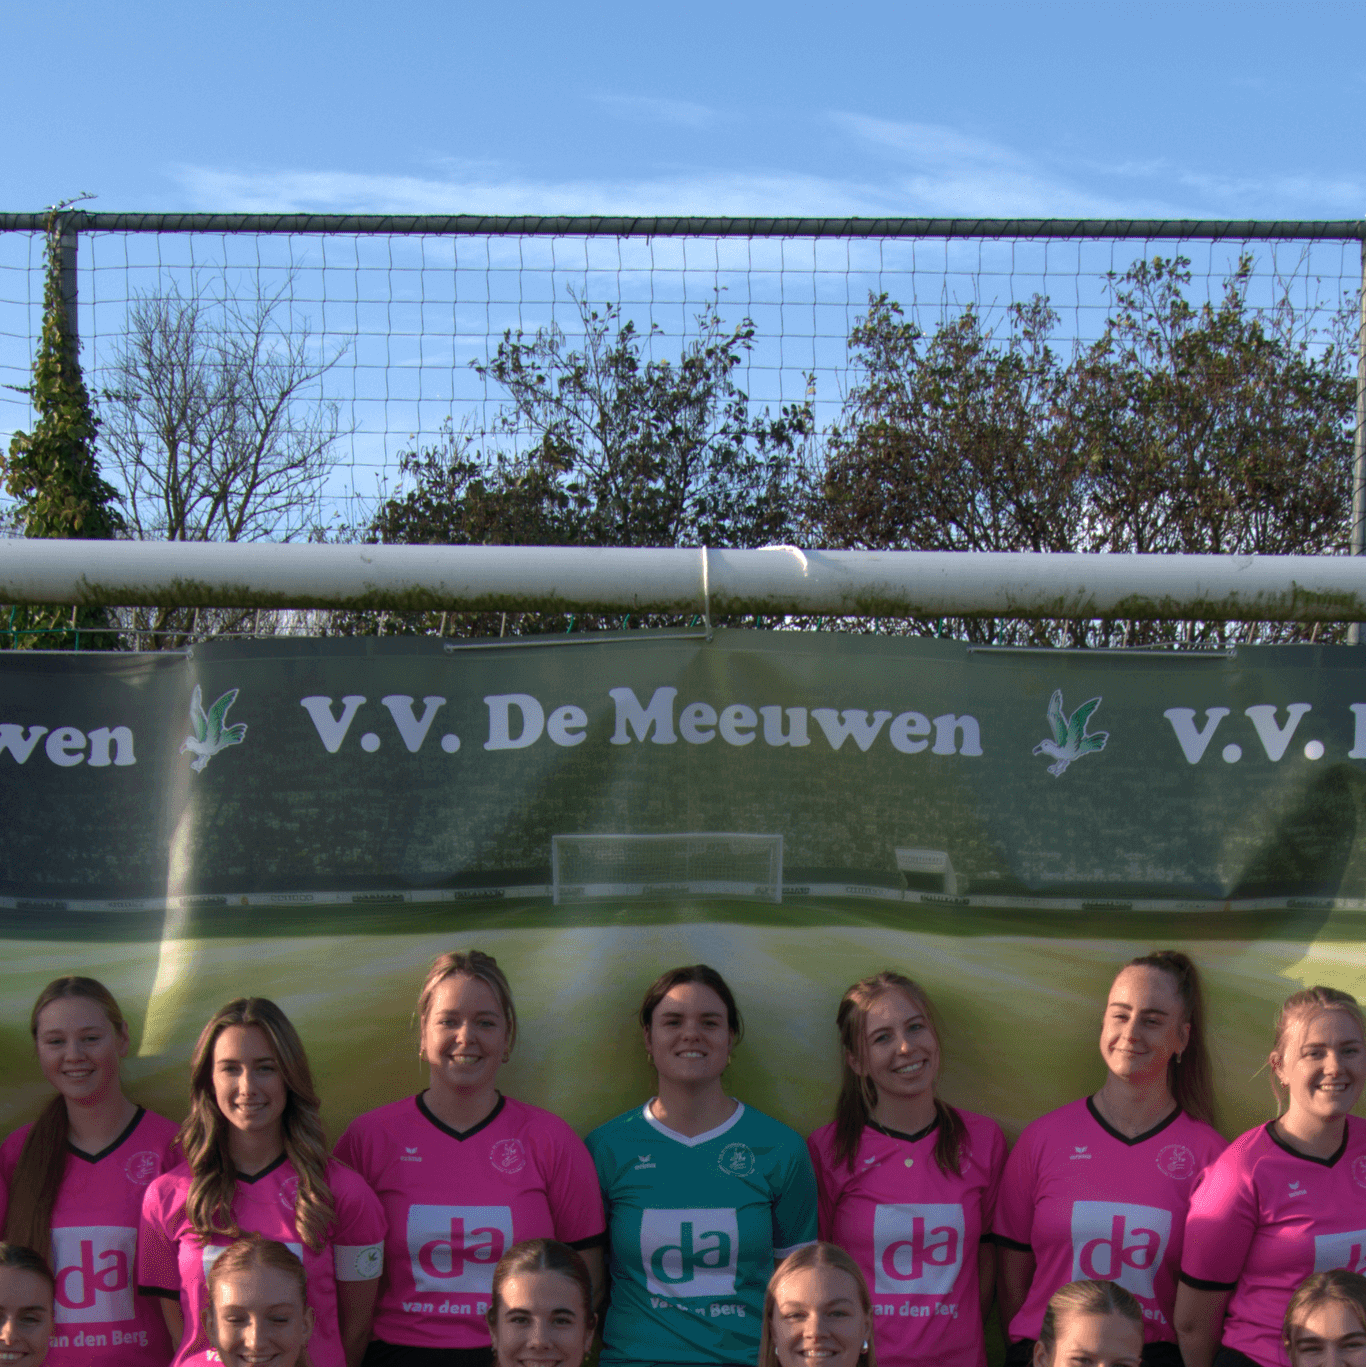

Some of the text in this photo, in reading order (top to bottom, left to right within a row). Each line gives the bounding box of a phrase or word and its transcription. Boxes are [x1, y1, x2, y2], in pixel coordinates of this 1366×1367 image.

[301, 686, 983, 757] V.V. De Meeuwen
[1163, 703, 1325, 765] V.V.
[54, 1240, 128, 1309] da
[418, 1217, 505, 1278] da
[652, 1221, 731, 1284] da
[882, 1217, 959, 1281] da
[1079, 1215, 1161, 1281] da
[401, 1301, 434, 1313] van
[438, 1300, 471, 1315] den
[899, 1301, 930, 1317] den
[49, 1330, 149, 1348] an den Berg
